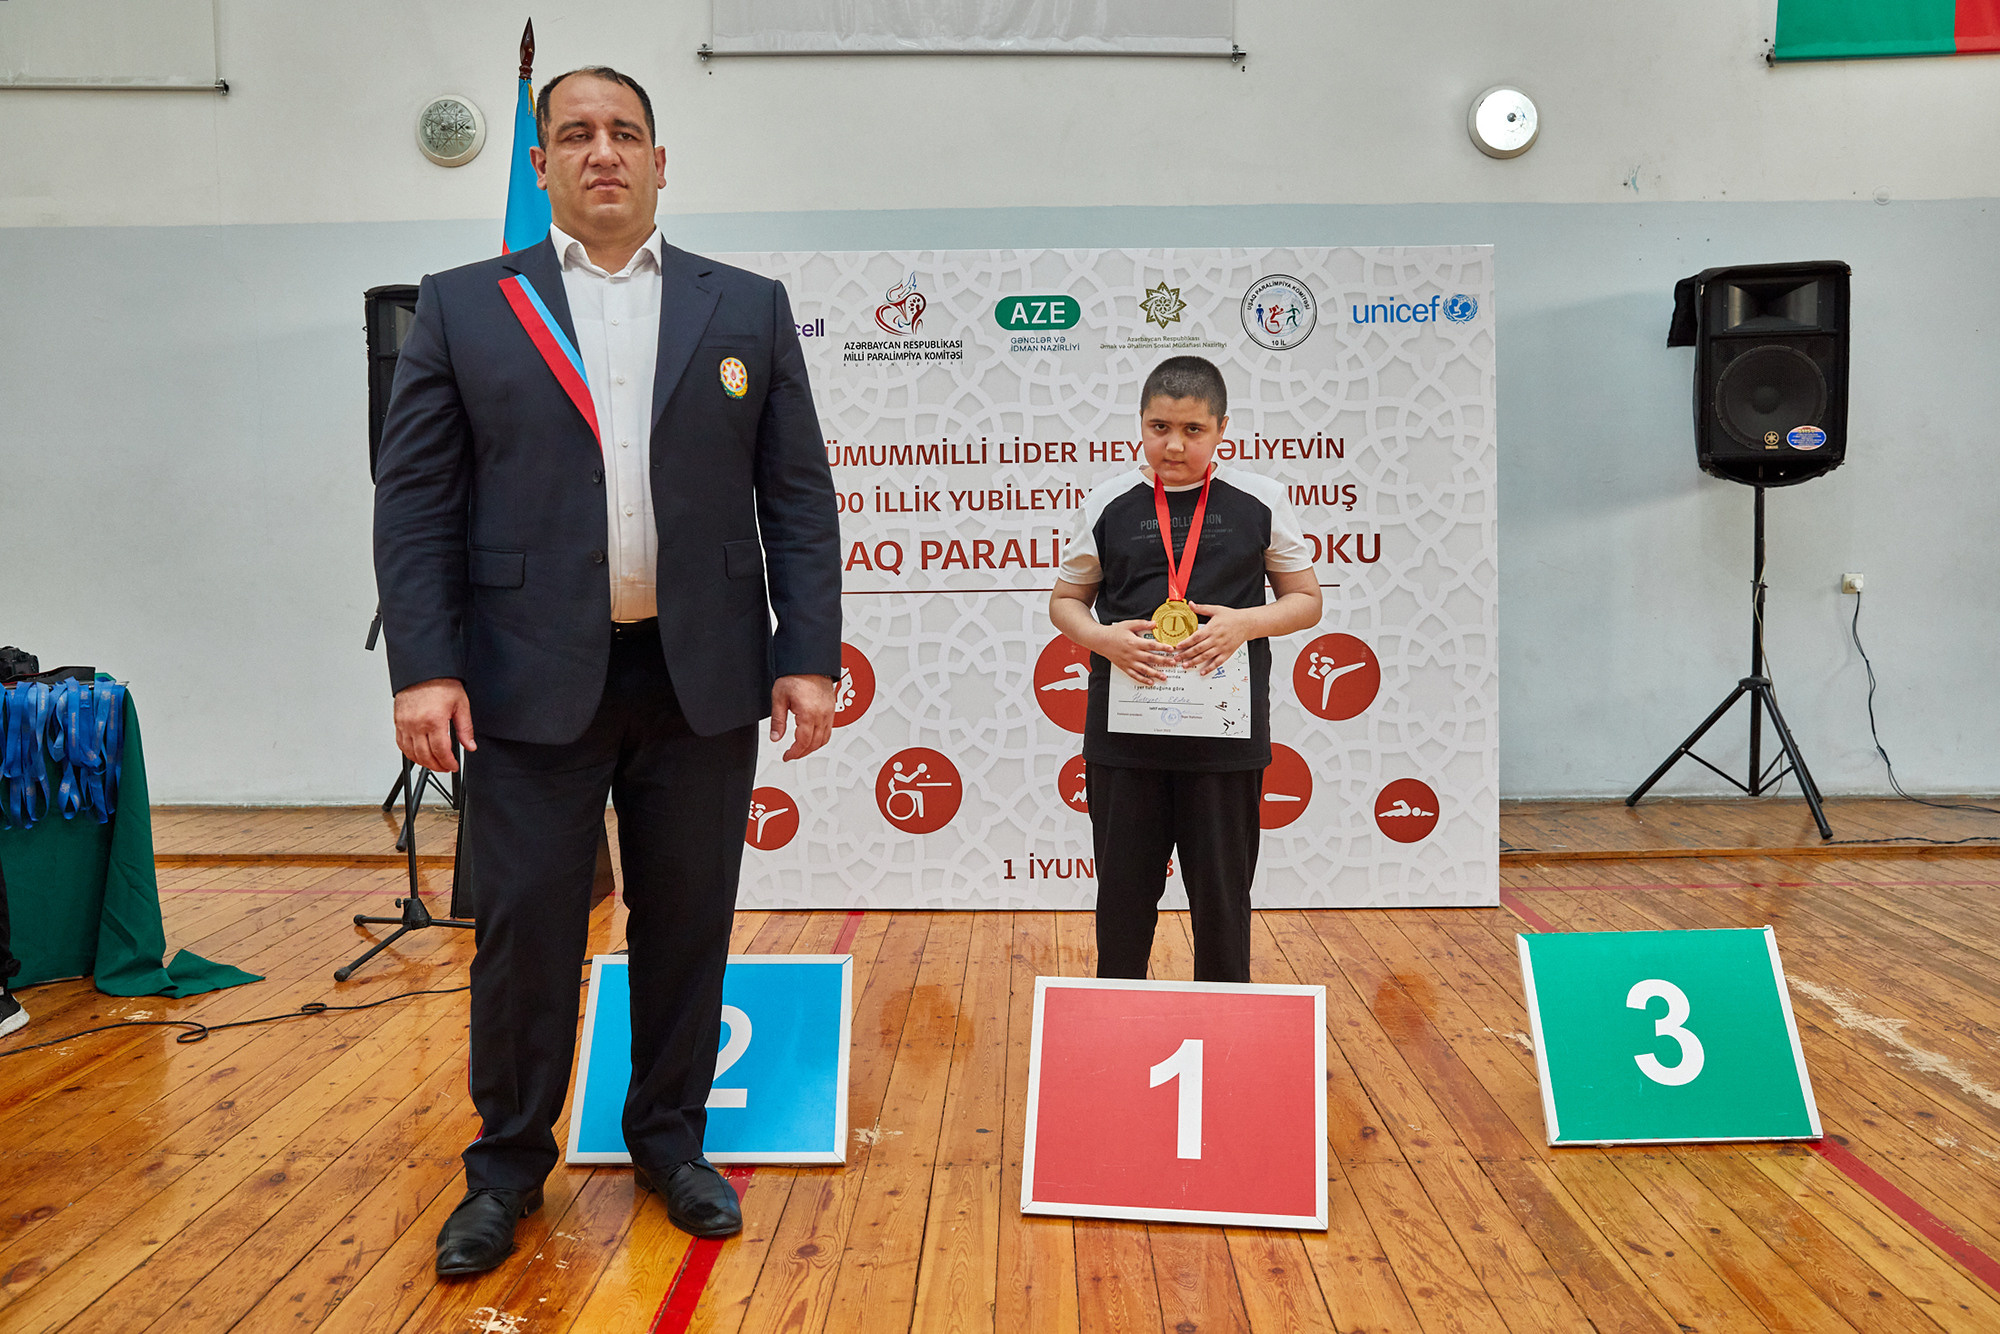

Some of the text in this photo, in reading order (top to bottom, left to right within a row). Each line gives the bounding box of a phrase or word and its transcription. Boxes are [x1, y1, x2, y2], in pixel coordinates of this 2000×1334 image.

[1247, 294, 1257, 310] UŞAQ
[1255, 281, 1291, 295] PARALİMPİYA
[1353, 295, 1440, 323] unicef
[1010, 302, 1065, 324] AZE
[843, 349, 963, 361] MİLLİ PARALİMPİYA KOMİTƏSİ
[844, 339, 963, 350] AZƏRBAYCAN RESPUBLİKASI
[1040, 342, 1080, 351] NAZİRLİYİ
[825, 432, 1344, 467] ÜMUMMİLLİ LİDER HEY ƏLİYEVİN
[836, 492, 864, 514] 00
[875, 485, 941, 513] İLLİK
[948, 483, 1093, 511] YUBİLEYİN
[1140, 518, 1159, 531] POR
[840, 540, 904, 576] AQ
[921, 529, 1071, 571] PARALİ
[1004, 859, 1016, 879] 1
[1029, 853, 1094, 879] İYUN
[1626, 979, 1705, 1086] 3
[705, 1004, 752, 1108] 2
[1149, 1039, 1203, 1160] 1
